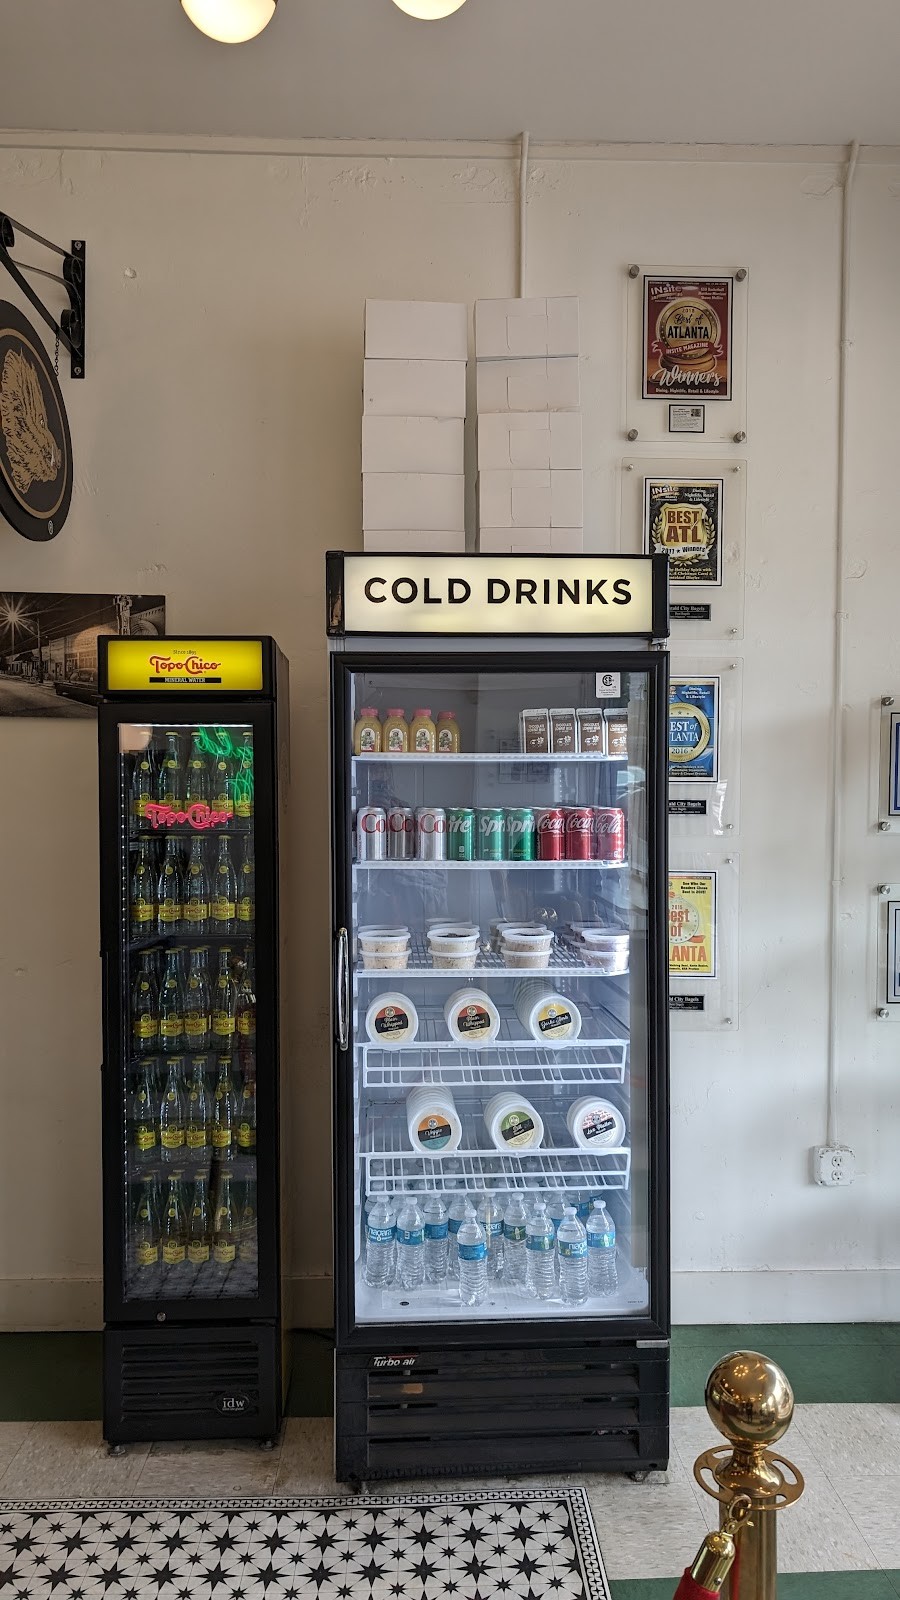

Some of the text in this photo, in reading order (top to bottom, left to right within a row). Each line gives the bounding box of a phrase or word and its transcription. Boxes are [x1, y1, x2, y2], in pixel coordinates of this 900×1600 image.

[674, 313, 704, 325] Best of
[667, 326, 710, 338] ATLANTA
[682, 342, 709, 351] MAGAZINE
[651, 364, 722, 386] Winners
[668, 511, 700, 524] BEST
[666, 526, 701, 542] ATL
[364, 577, 632, 605] COLD DRINKS
[149, 656, 221, 674] Topo Chico
[670, 721, 699, 731] EST of
[670, 731, 699, 741] LANTA
[144, 803, 234, 830] Topo Chico
[362, 814, 386, 833] Co
[389, 813, 414, 832] Co
[420, 814, 446, 833] Co
[449, 816, 471, 832] ite
[479, 816, 505, 836] Spr
[507, 816, 535, 836] Spri
[670, 909, 690, 922] est
[671, 923, 683, 937] of
[671, 946, 707, 961] ANTA
[369, 1229, 392, 1241] niagara
[373, 1356, 416, 1367] Turbo air
[223, 1397, 245, 1408] idw
